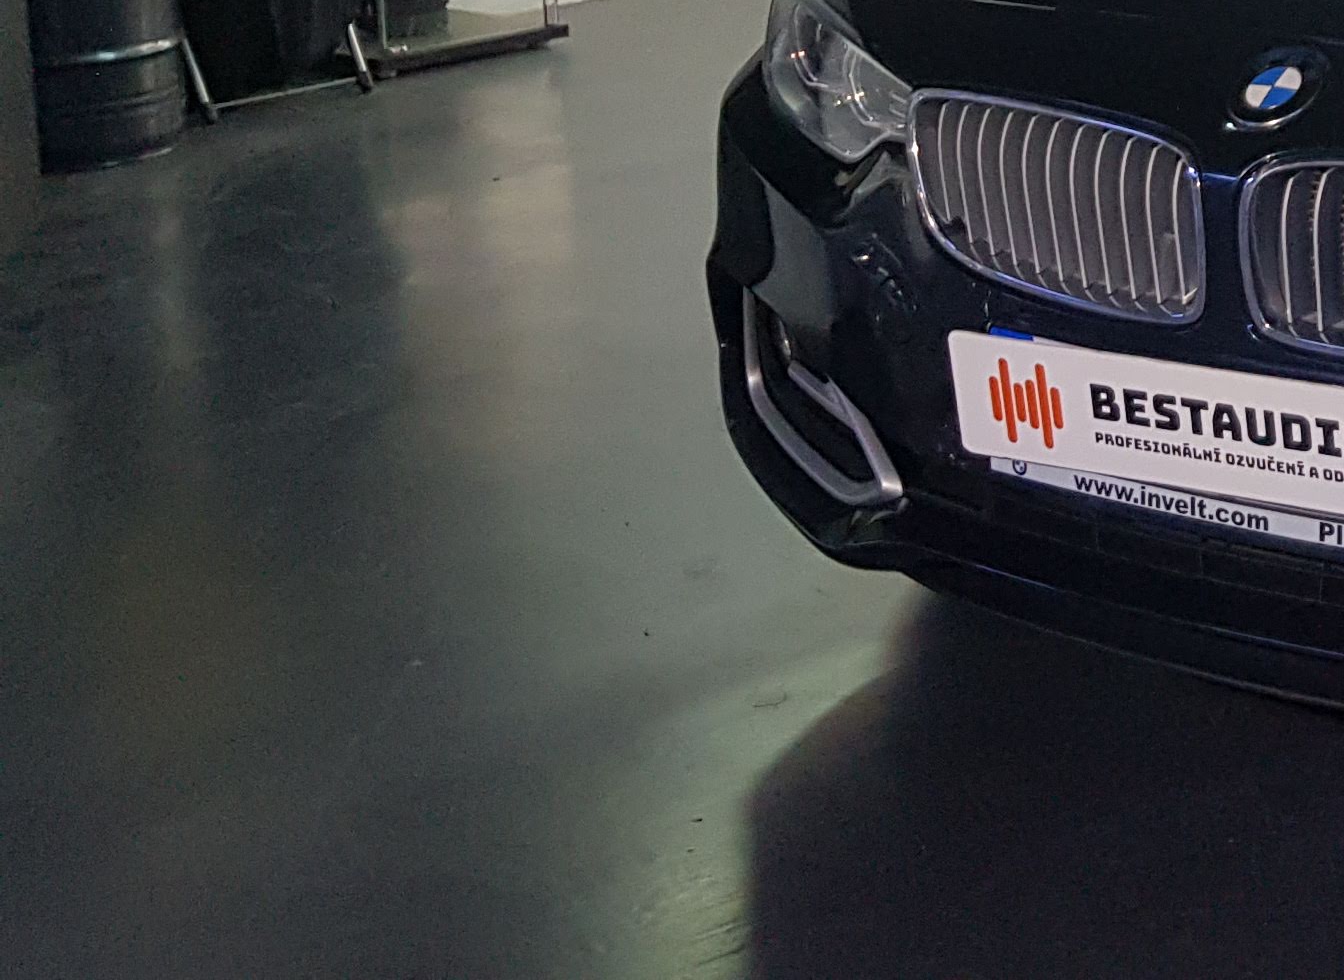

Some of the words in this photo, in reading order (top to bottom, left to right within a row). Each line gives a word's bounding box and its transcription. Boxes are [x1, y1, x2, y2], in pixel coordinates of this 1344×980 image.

[1095, 431, 1222, 464] PROFESIONÁLNÍ
[1225, 452, 1306, 477] OZVUČENÍ
[1309, 466, 1320, 479] A
[1073, 474, 1269, 531] www.invelt.com
